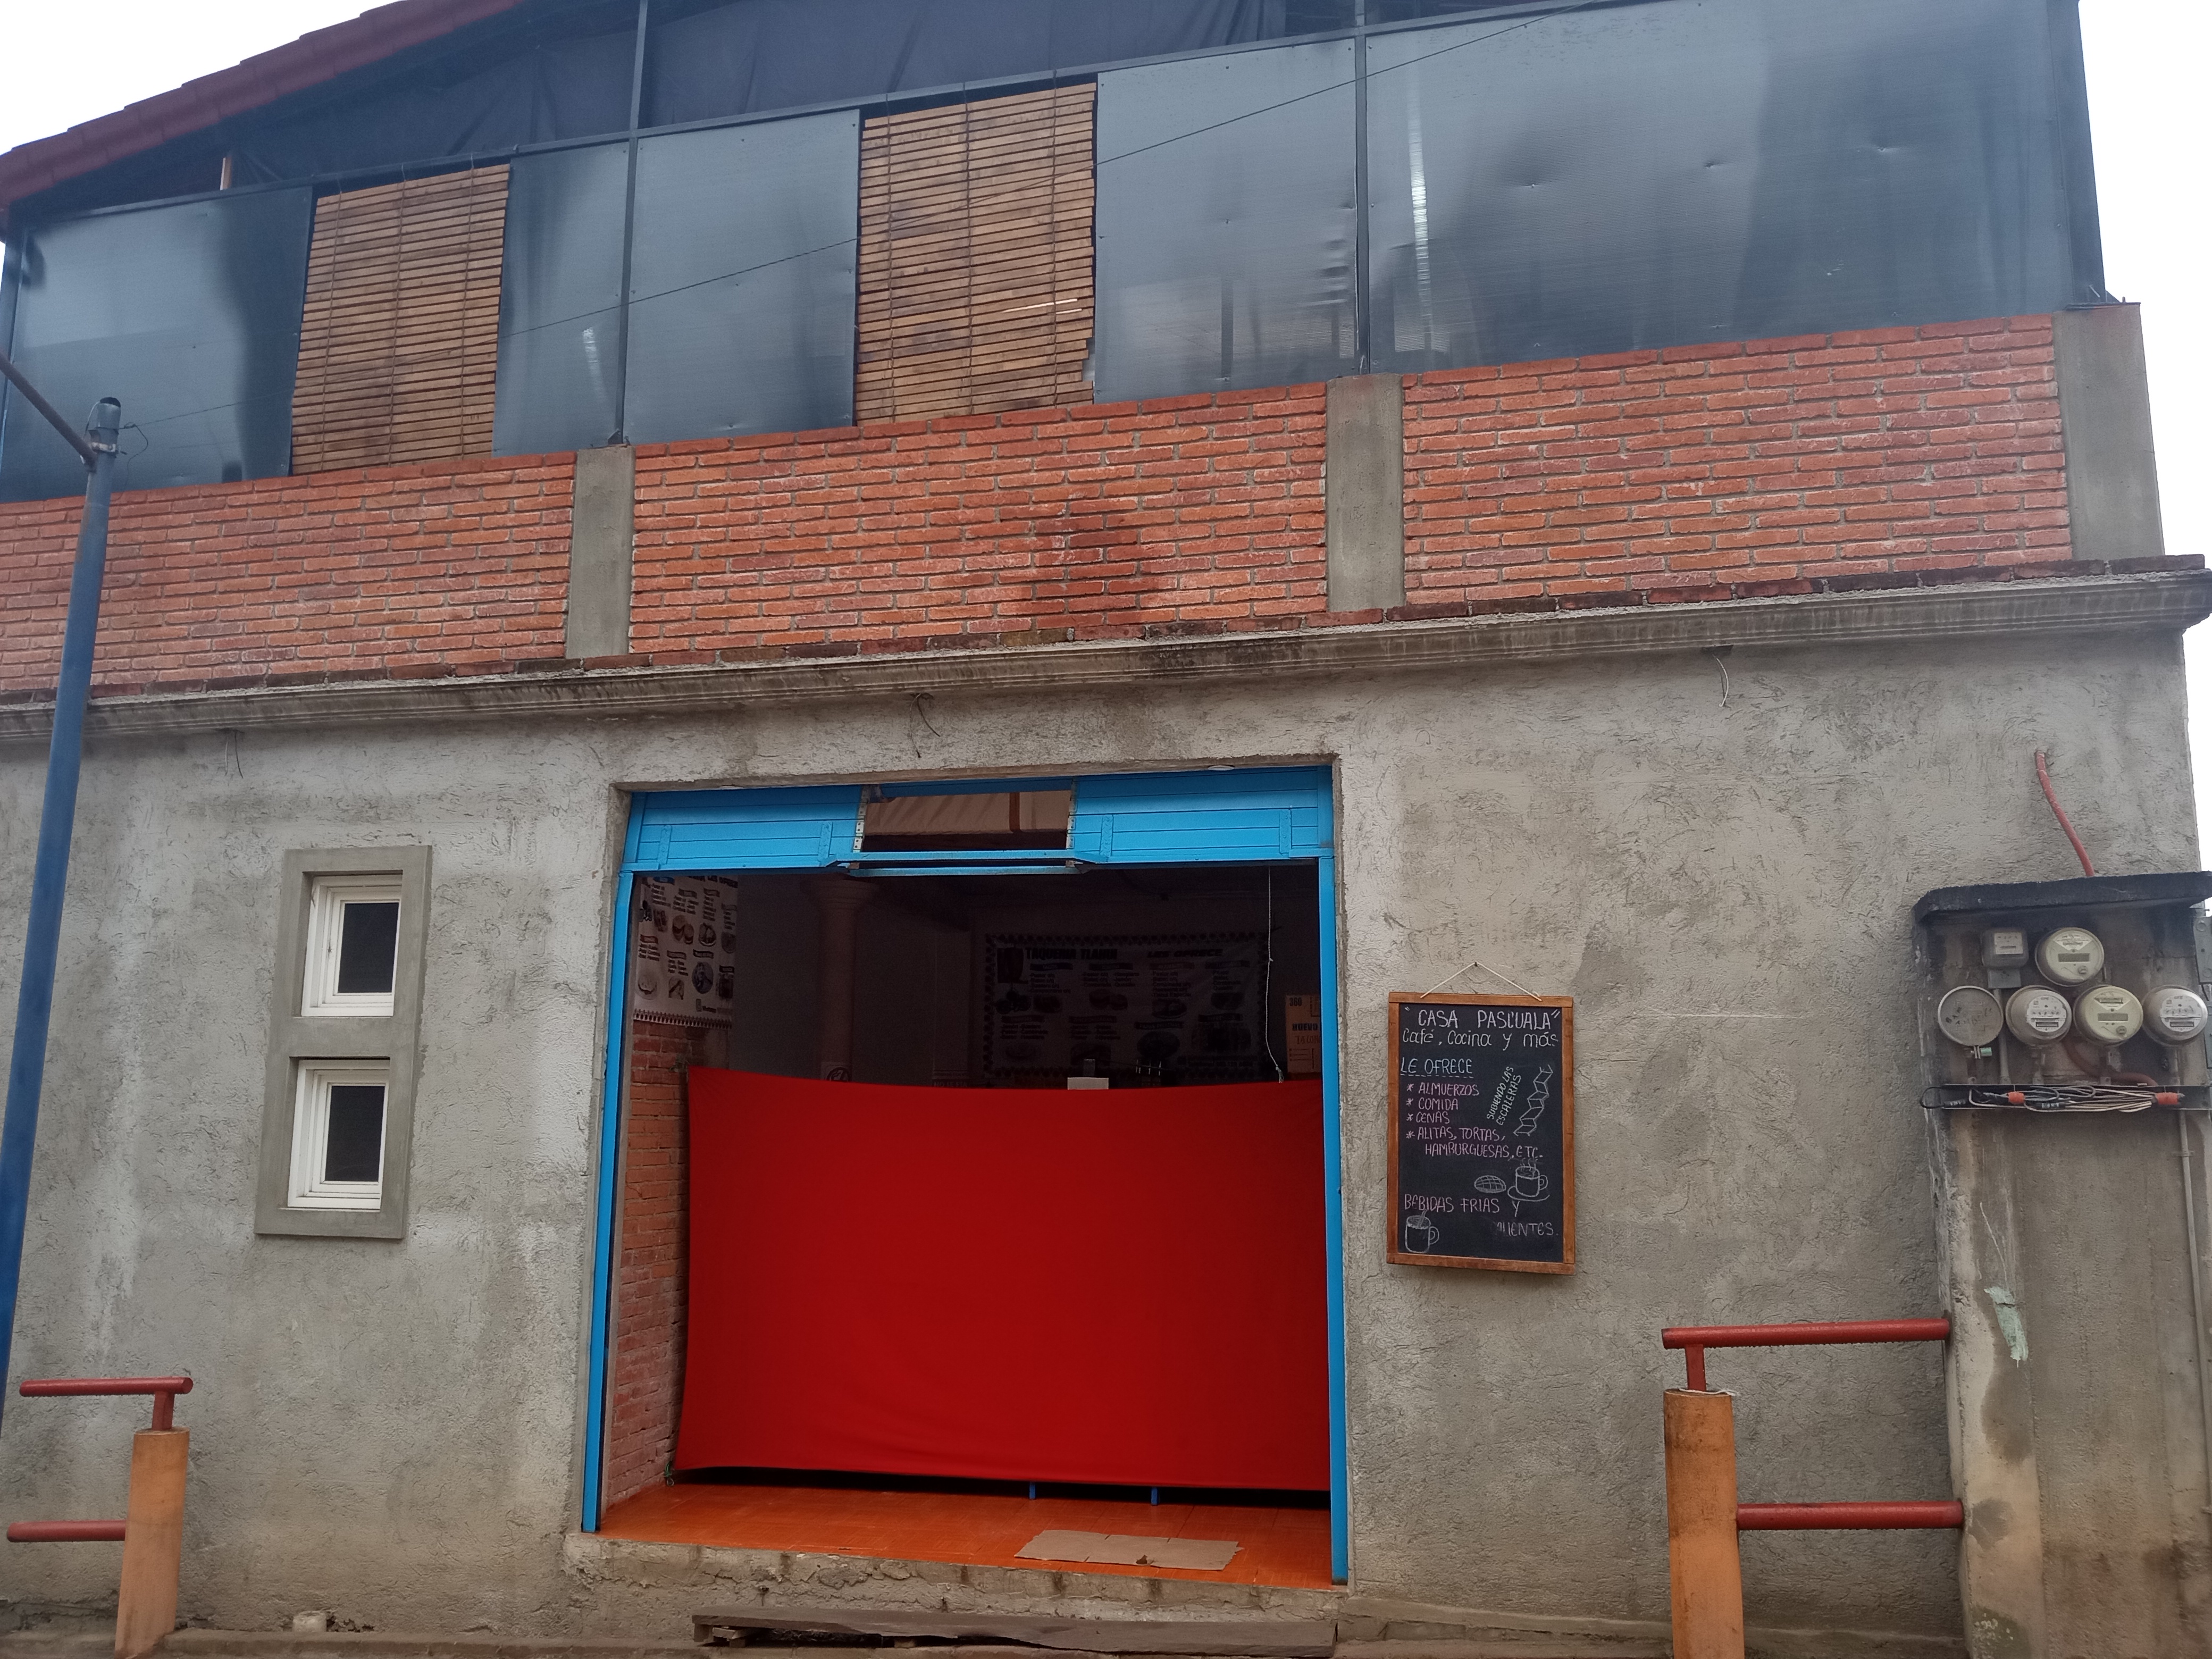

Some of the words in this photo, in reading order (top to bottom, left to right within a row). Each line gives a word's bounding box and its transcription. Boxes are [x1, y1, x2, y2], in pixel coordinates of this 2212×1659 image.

[1174, 949, 1223, 958] OFRECE
[1289, 997, 1302, 1007] 360
[1447, 1030, 1492, 1047] Cocina
[1401, 1057, 1418, 1074] LE
[1424, 1058, 1473, 1074] OFRECE
[1418, 1082, 1480, 1096] ALMUERZOS
[1486, 1083, 1506, 1120] SUBIENDO
[1502, 1066, 1514, 1083] LAS
[1418, 1097, 1459, 1111] COMIDA
[1496, 1075, 1521, 1126] ESCALERAS
[1415, 1111, 1451, 1124] CENAS
[1404, 1194, 1454, 1213] BEBIDAS
[1460, 1197, 1500, 1213] FRIAS
